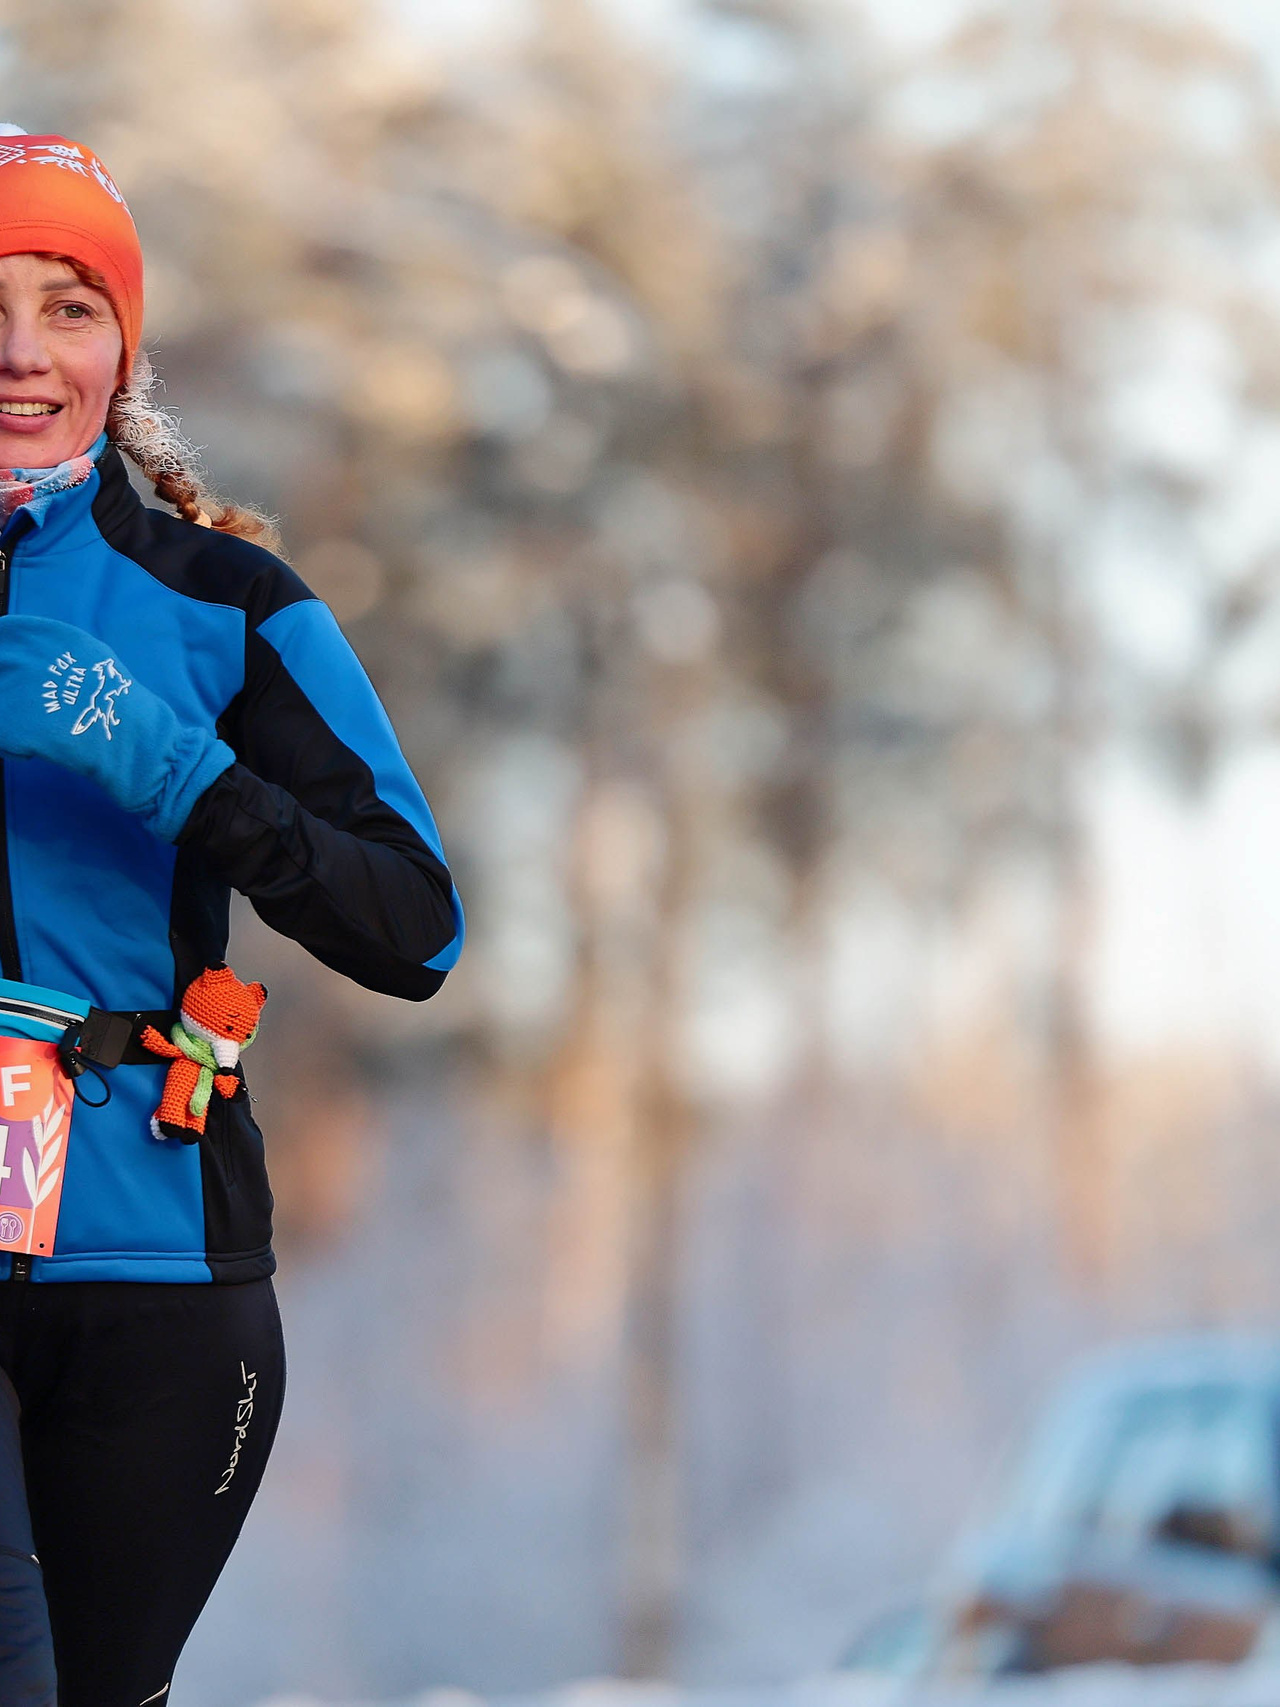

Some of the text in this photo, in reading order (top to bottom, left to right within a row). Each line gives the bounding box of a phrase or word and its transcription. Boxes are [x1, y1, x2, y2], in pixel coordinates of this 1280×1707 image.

[42, 651, 78, 714] MAD FOX
[62, 667, 87, 705] ULTRA
[0, 1065, 31, 1107] F
